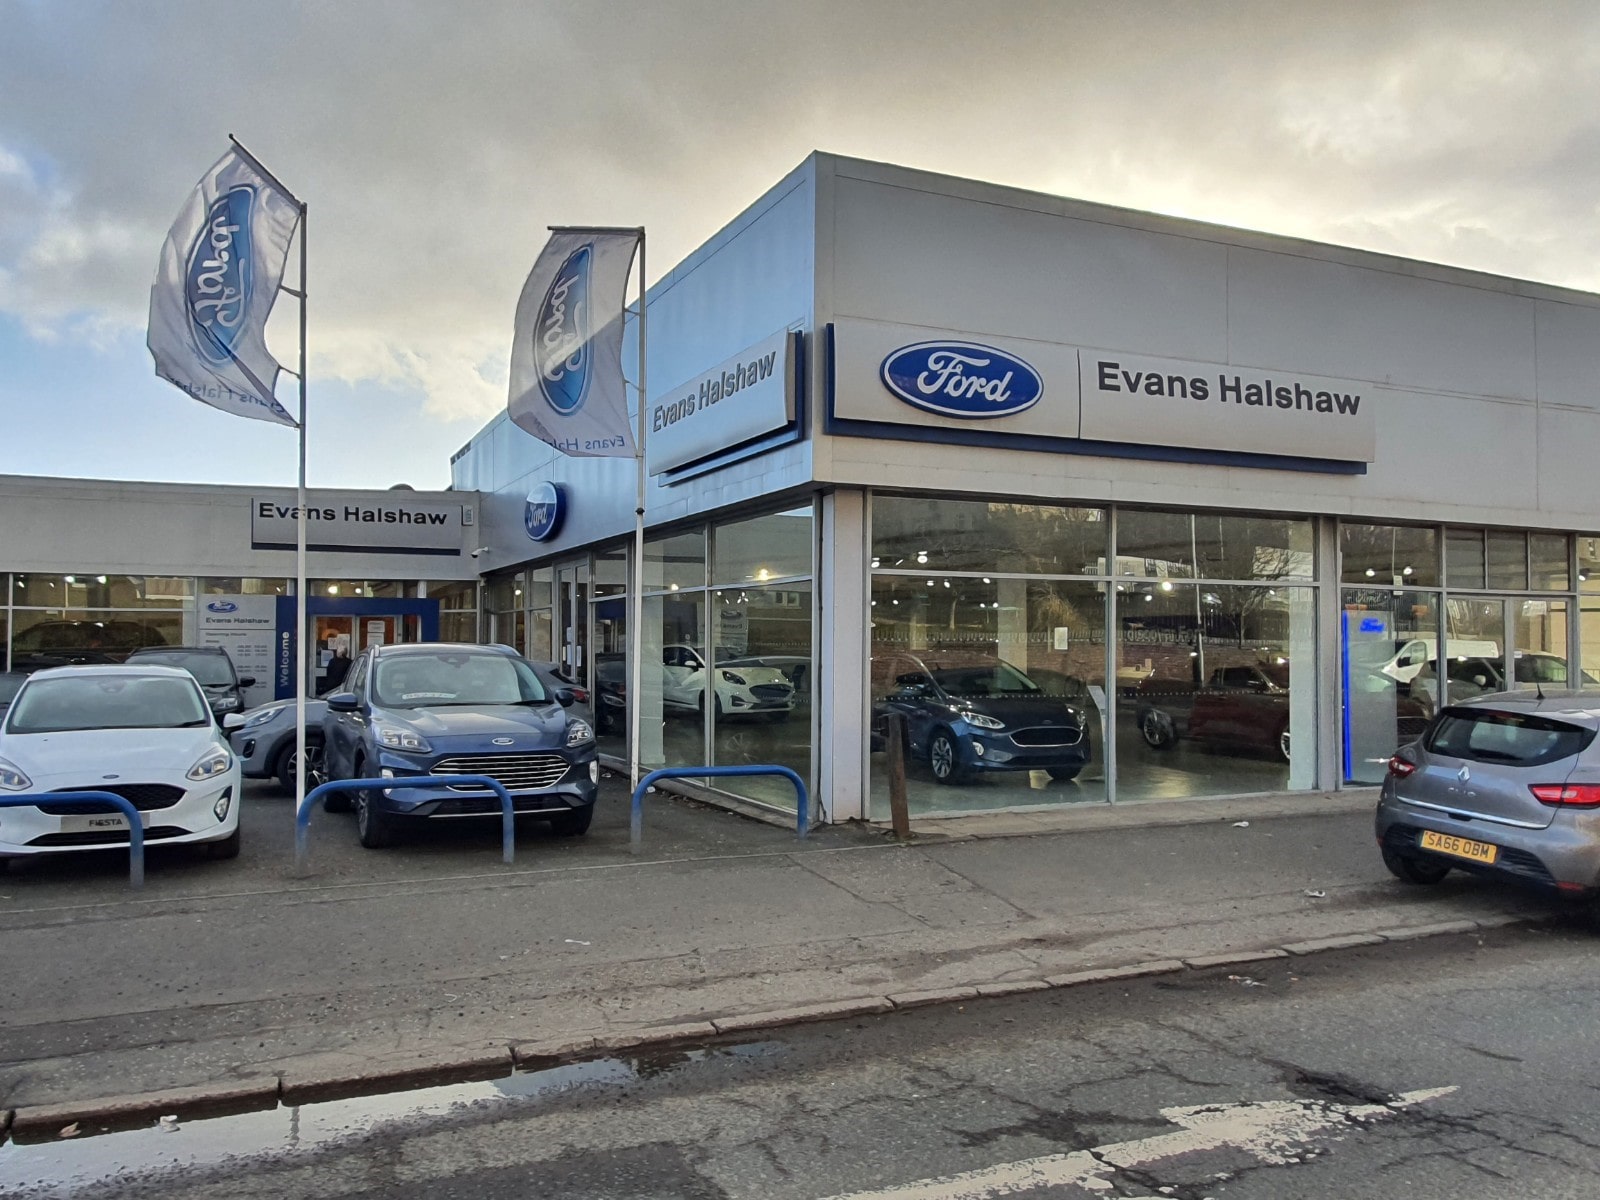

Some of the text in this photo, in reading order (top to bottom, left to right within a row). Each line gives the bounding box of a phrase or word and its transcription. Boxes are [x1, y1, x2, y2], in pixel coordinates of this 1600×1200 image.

[653, 351, 777, 433] Evans Halshaw
[916, 350, 1012, 402] Ford
[1098, 361, 1361, 416] Evans Halshaw
[344, 506, 447, 525] Halshaw
[280, 631, 290, 687] Welcome
[88, 818, 123, 827] FIESTA
[1428, 833, 1490, 858] SA66 OBM
